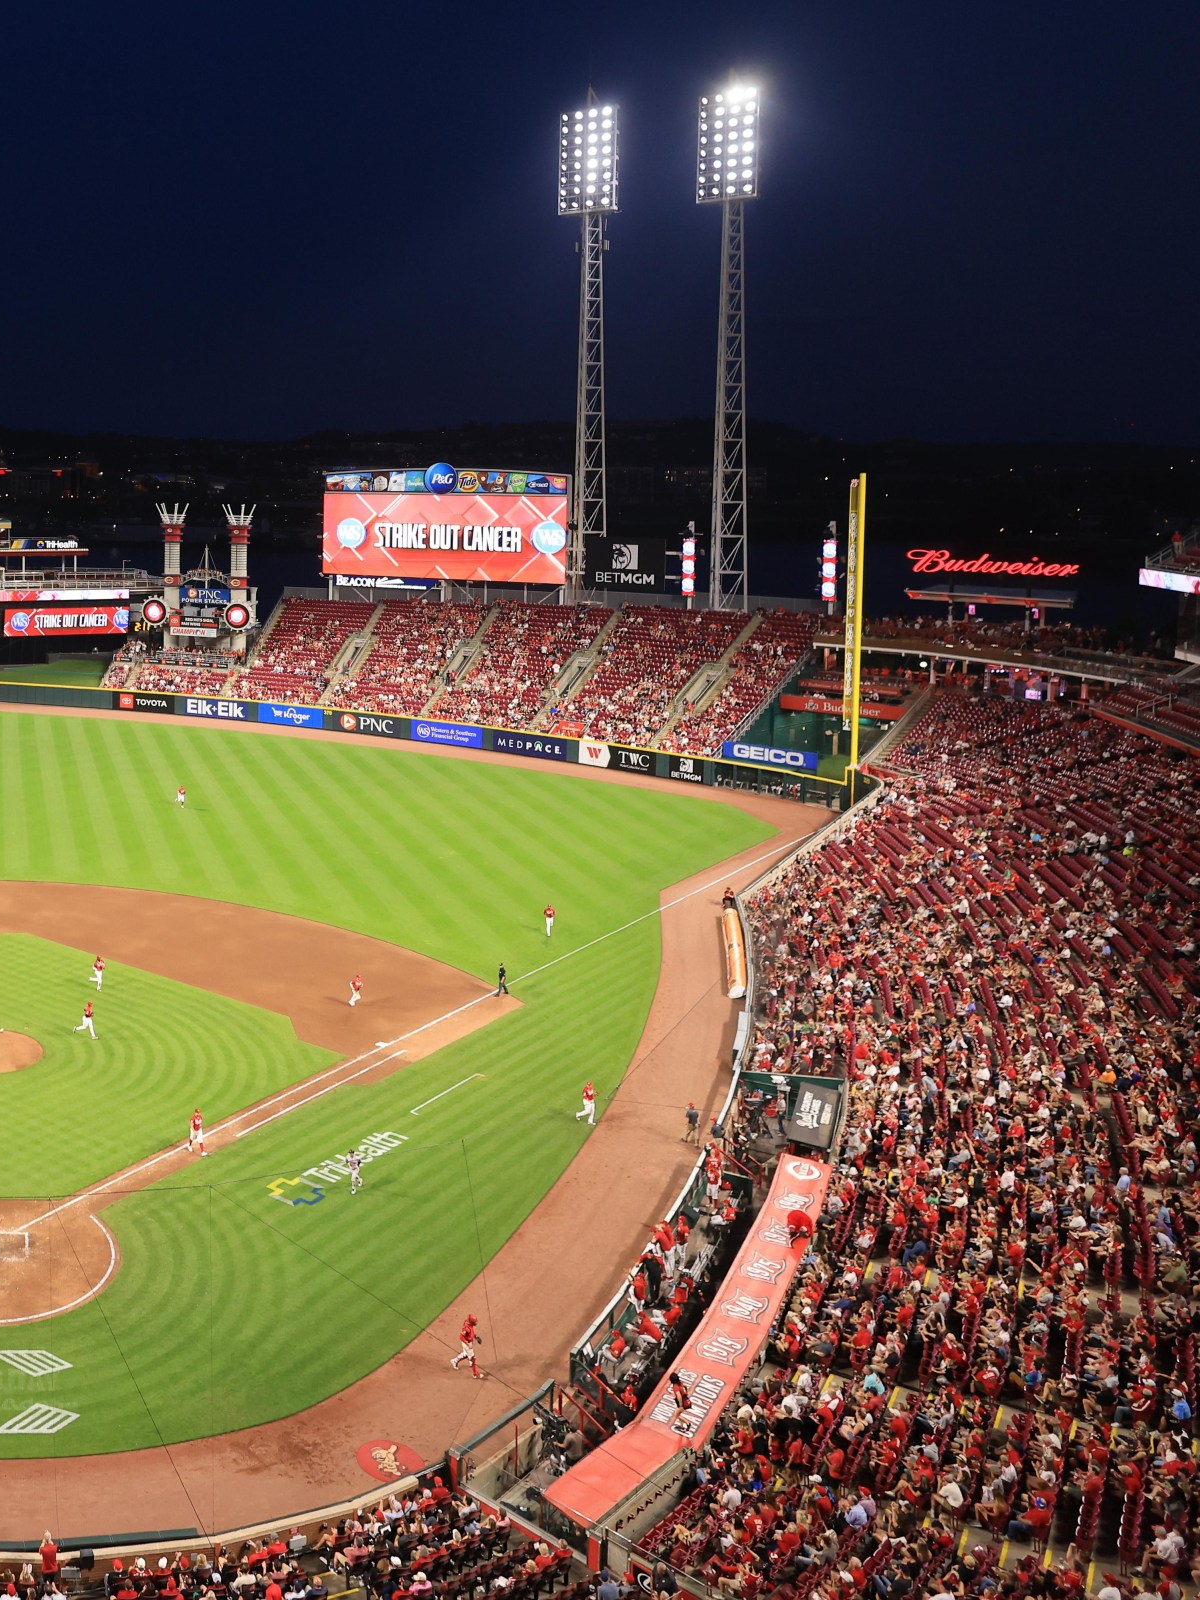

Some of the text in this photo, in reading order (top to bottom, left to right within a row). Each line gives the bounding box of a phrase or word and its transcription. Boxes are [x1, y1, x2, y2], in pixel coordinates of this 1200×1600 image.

[430, 473, 454, 485] P&G
[459, 475, 477, 488] Tide
[44, 540, 79, 549] TriHealth
[373, 522, 522, 553] STRIKE OUT CANCER
[906, 549, 1080, 577] Budweiser
[335, 575, 377, 588] BEACON
[595, 571, 655, 585] BETMGM
[198, 589, 221, 600] PNC
[34, 613, 108, 628] STRIKE OUT CANCER
[135, 699, 168, 708] TOYOTA
[823, 701, 881, 717] Budwiser
[283, 708, 311, 725] Kroger
[358, 716, 394, 734] PNC
[430, 726, 450, 734] Western
[455, 729, 477, 738] Southern
[431, 732, 470, 743] Financial Group
[497, 738, 562, 755] MEDPACE
[617, 750, 650, 768] TWC
[732, 743, 804, 767] GEICO
[670, 770, 702, 782] BETMGM
[746, 1259, 782, 1285] 1975
[725, 1295, 763, 1321] 1940
[702, 1335, 743, 1363] 1919
[649, 1387, 677, 1425] WORLD
